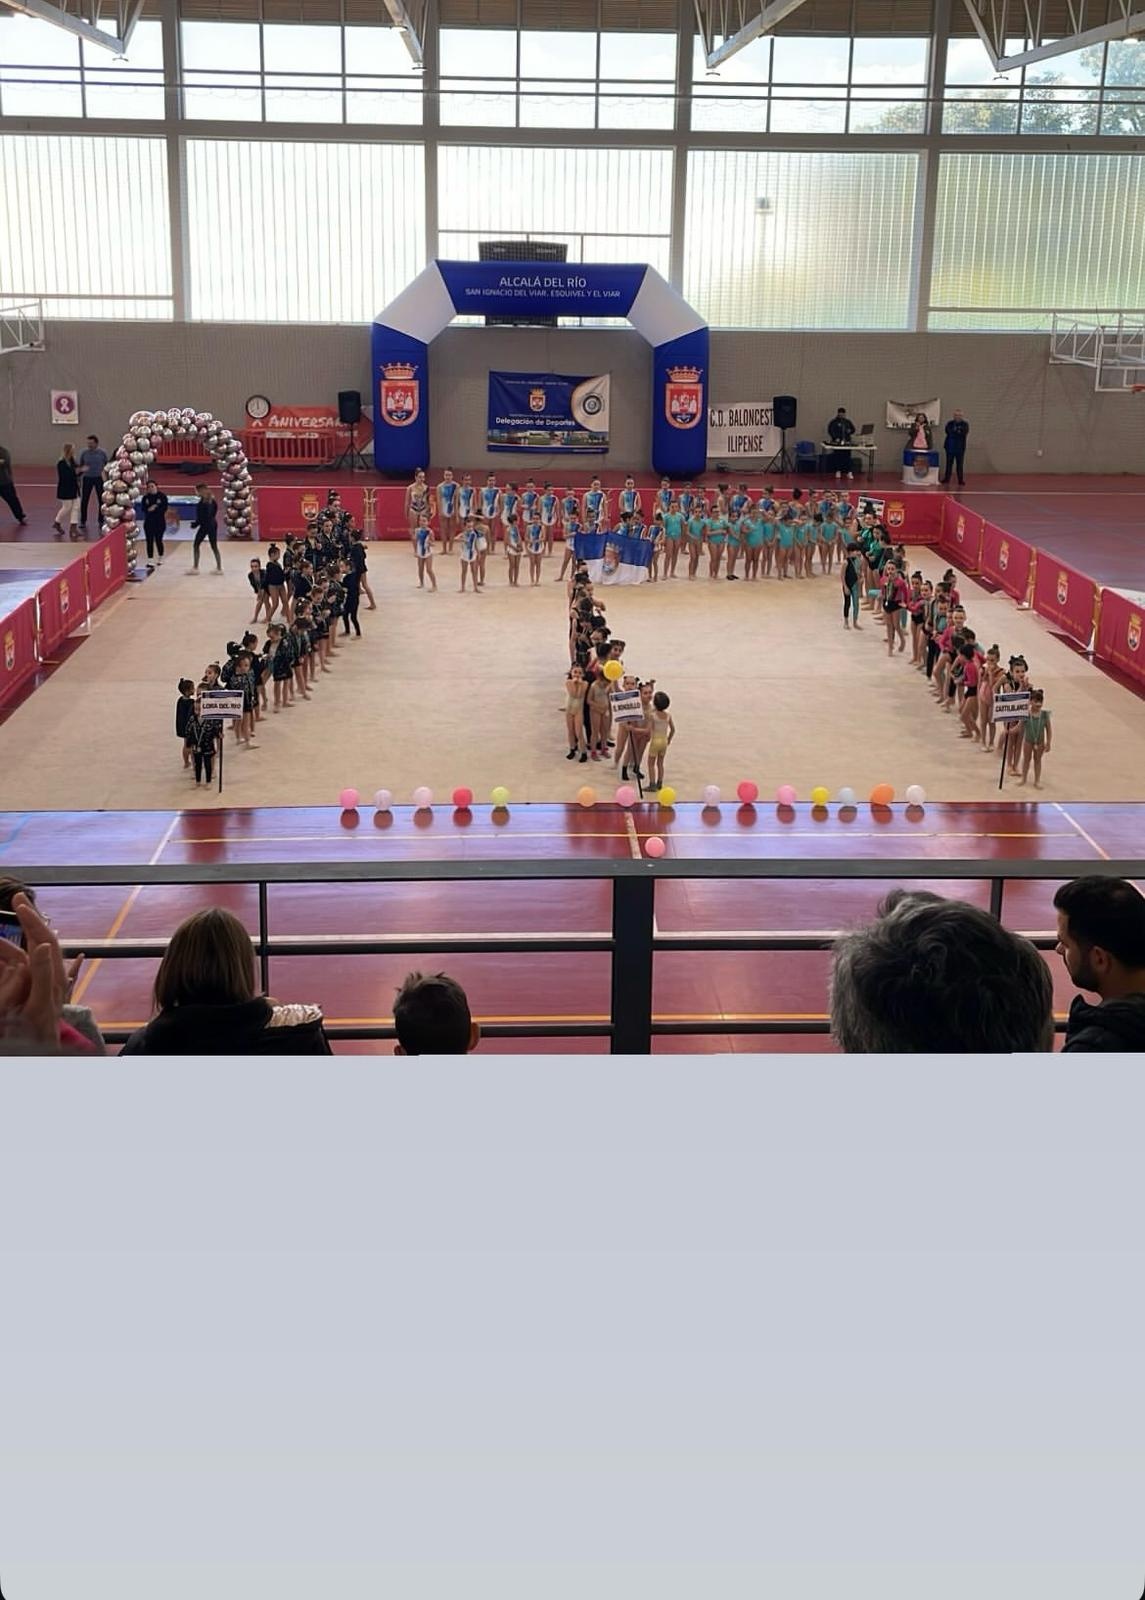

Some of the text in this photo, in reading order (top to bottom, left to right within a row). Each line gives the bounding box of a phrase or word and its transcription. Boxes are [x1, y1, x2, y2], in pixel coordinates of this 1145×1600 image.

[500, 275, 587, 289] ALCALÁ DEL RÍO
[465, 287, 481, 296] SAN
[482, 288, 513, 297] IGNACIO
[514, 289, 527, 297] DEL
[550, 290, 585, 298] ESQUIVEL
[587, 290, 592, 298] Y
[593, 290, 602, 298] EL
[602, 290, 621, 298] VIAR
[495, 417, 534, 426] Delegación
[546, 419, 576, 428] Deportes
[710, 408, 774, 427] C.D. BALONCEST
[728, 435, 764, 453] ILIPENSE
